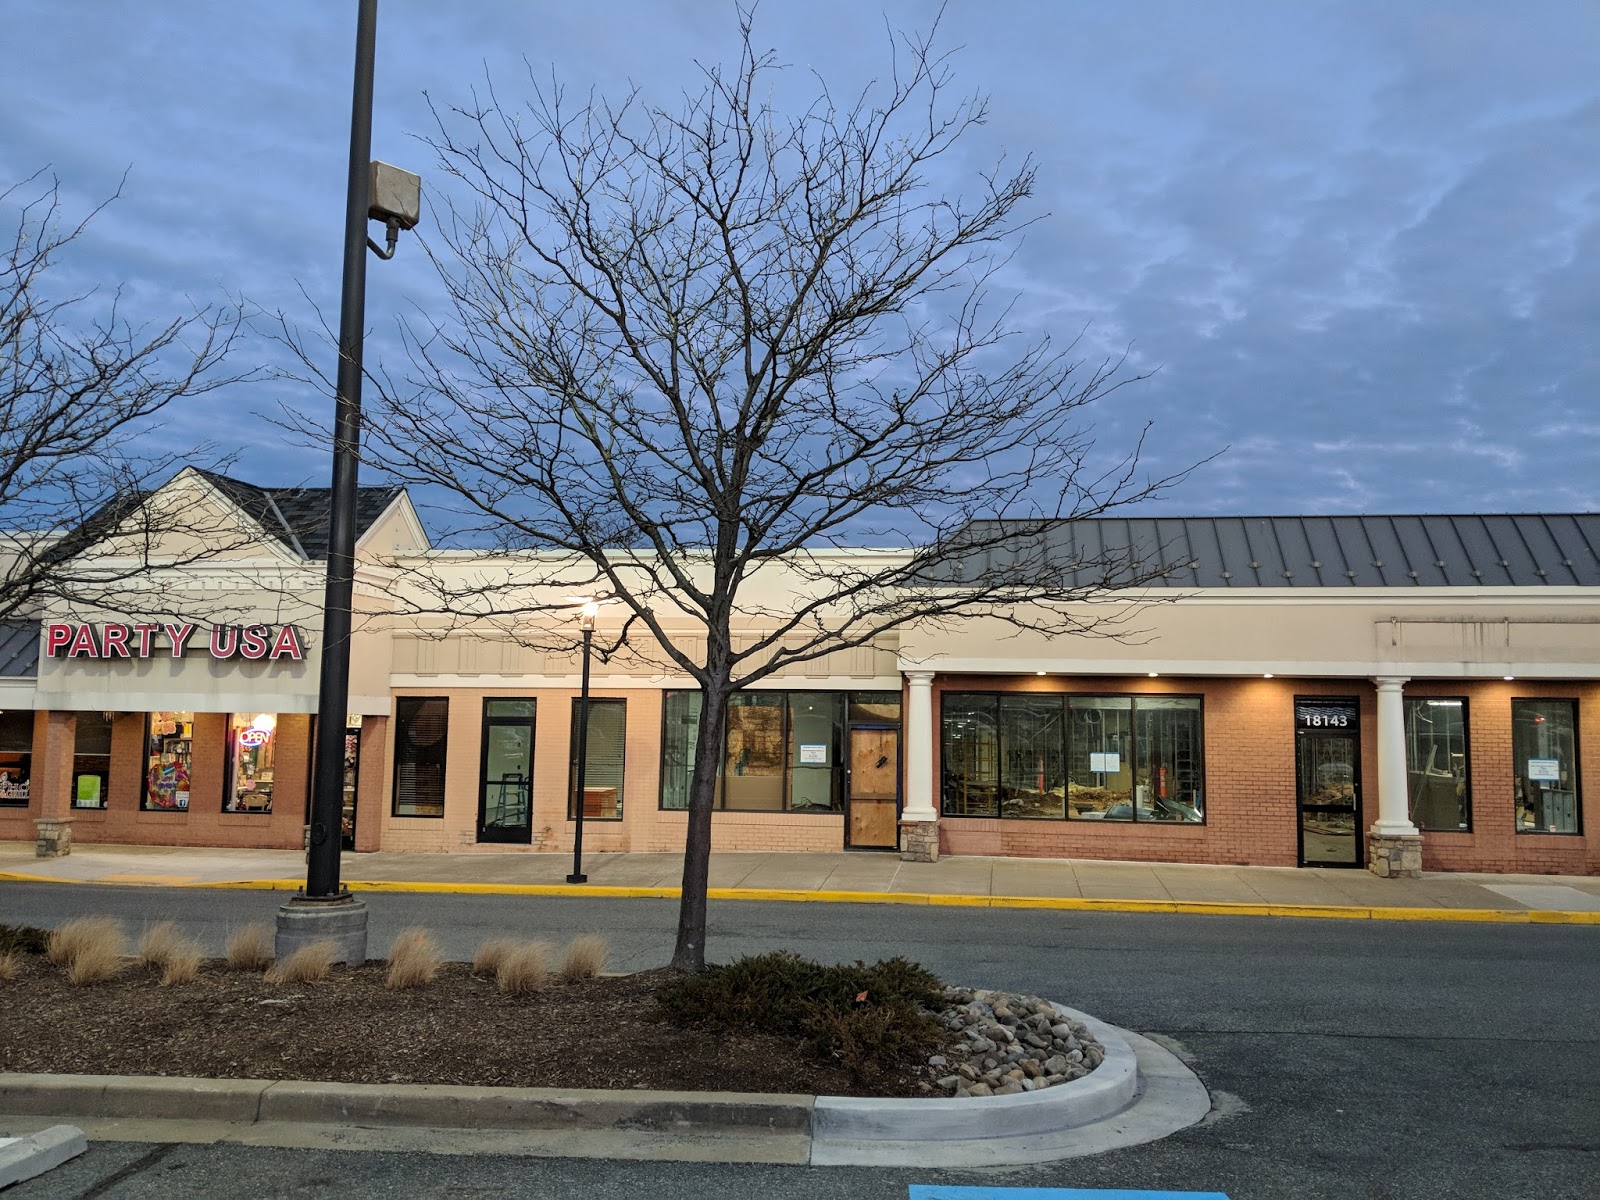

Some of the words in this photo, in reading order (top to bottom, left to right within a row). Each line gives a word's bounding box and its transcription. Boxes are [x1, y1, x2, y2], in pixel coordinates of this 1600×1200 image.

[46, 623, 192, 658] PARTY
[209, 623, 302, 660] USA
[1304, 714, 1348, 727] 18143
[241, 731, 269, 744] OPEN
